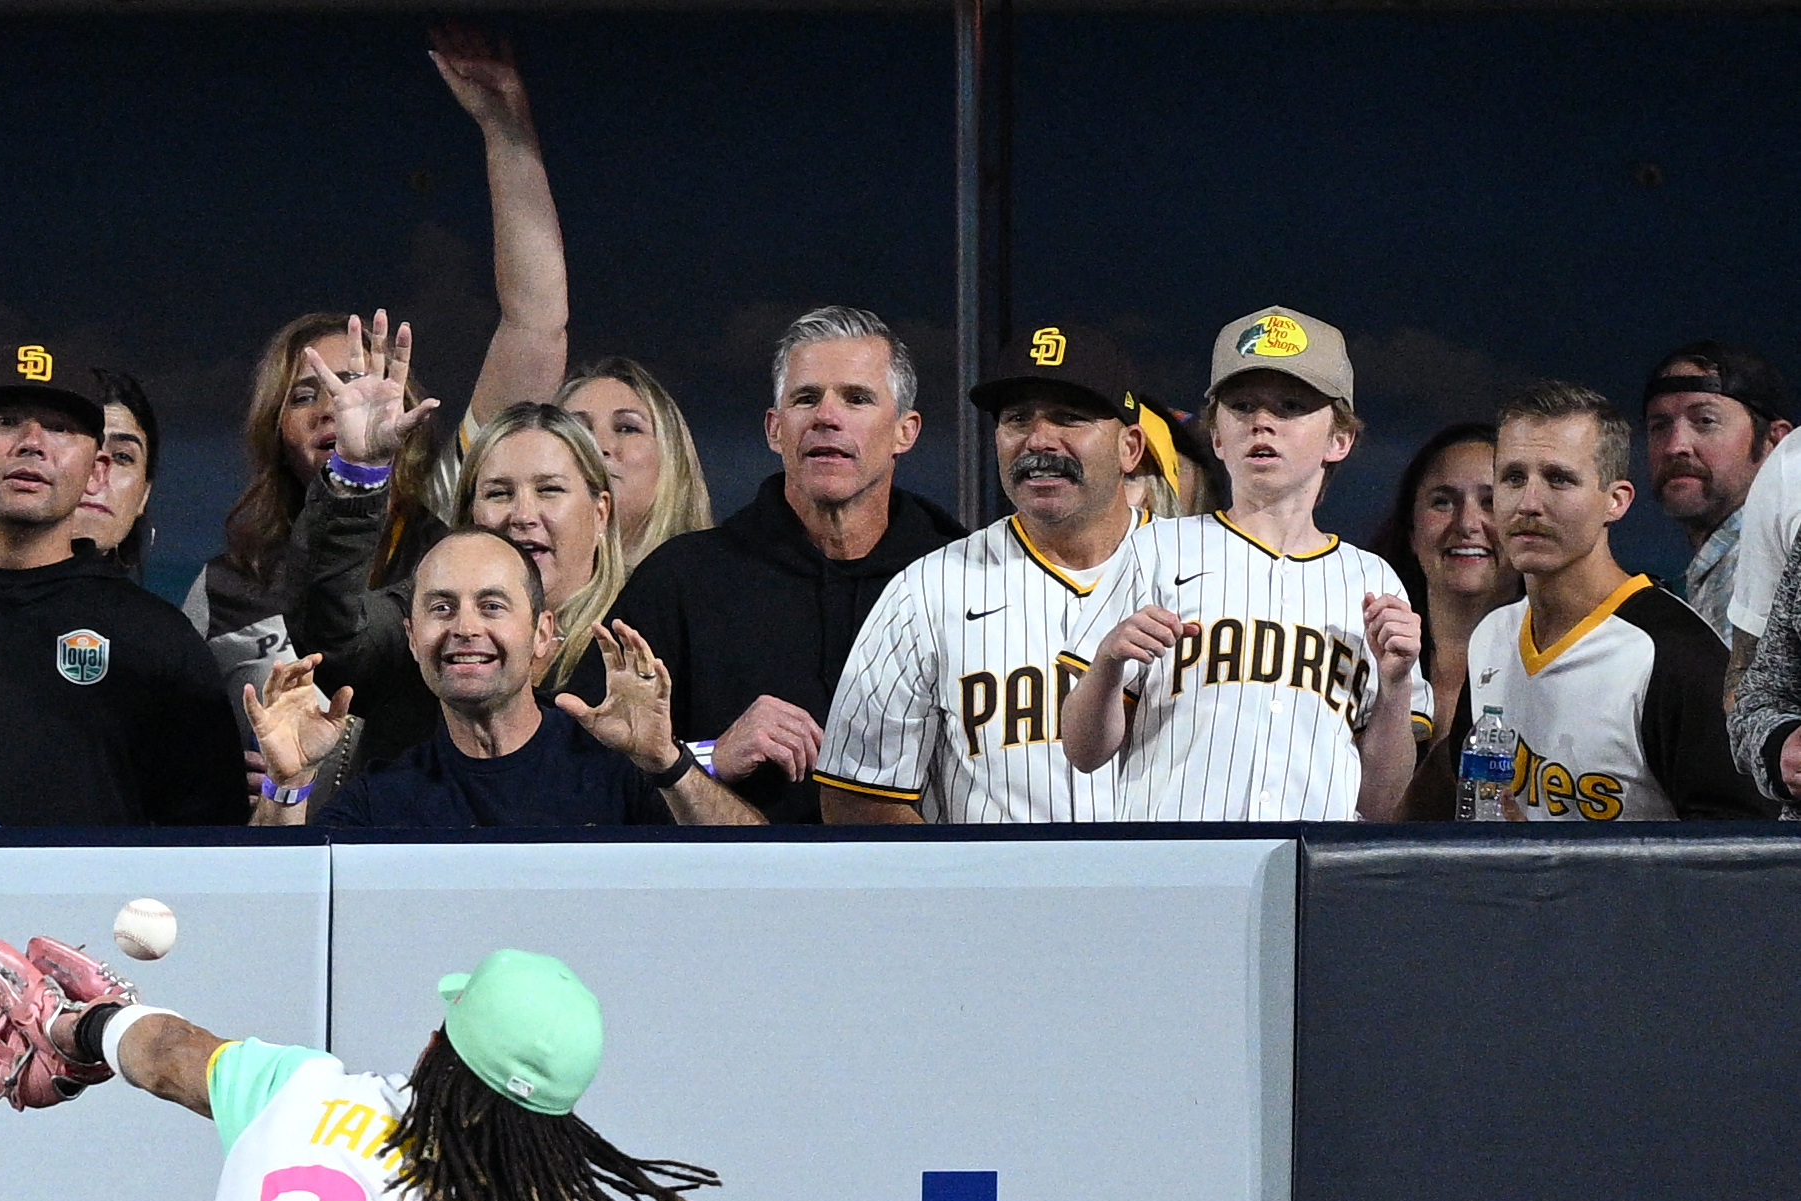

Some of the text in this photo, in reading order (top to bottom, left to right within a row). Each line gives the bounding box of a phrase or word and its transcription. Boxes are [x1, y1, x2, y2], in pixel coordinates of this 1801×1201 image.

[1267, 317, 1296, 330] Bass
[1267, 327, 1288, 339] Pro
[1030, 327, 1067, 366] SD
[1263, 337, 1301, 353] Shops
[17, 345, 53, 382] SD
[62, 642, 103, 682] loyal
